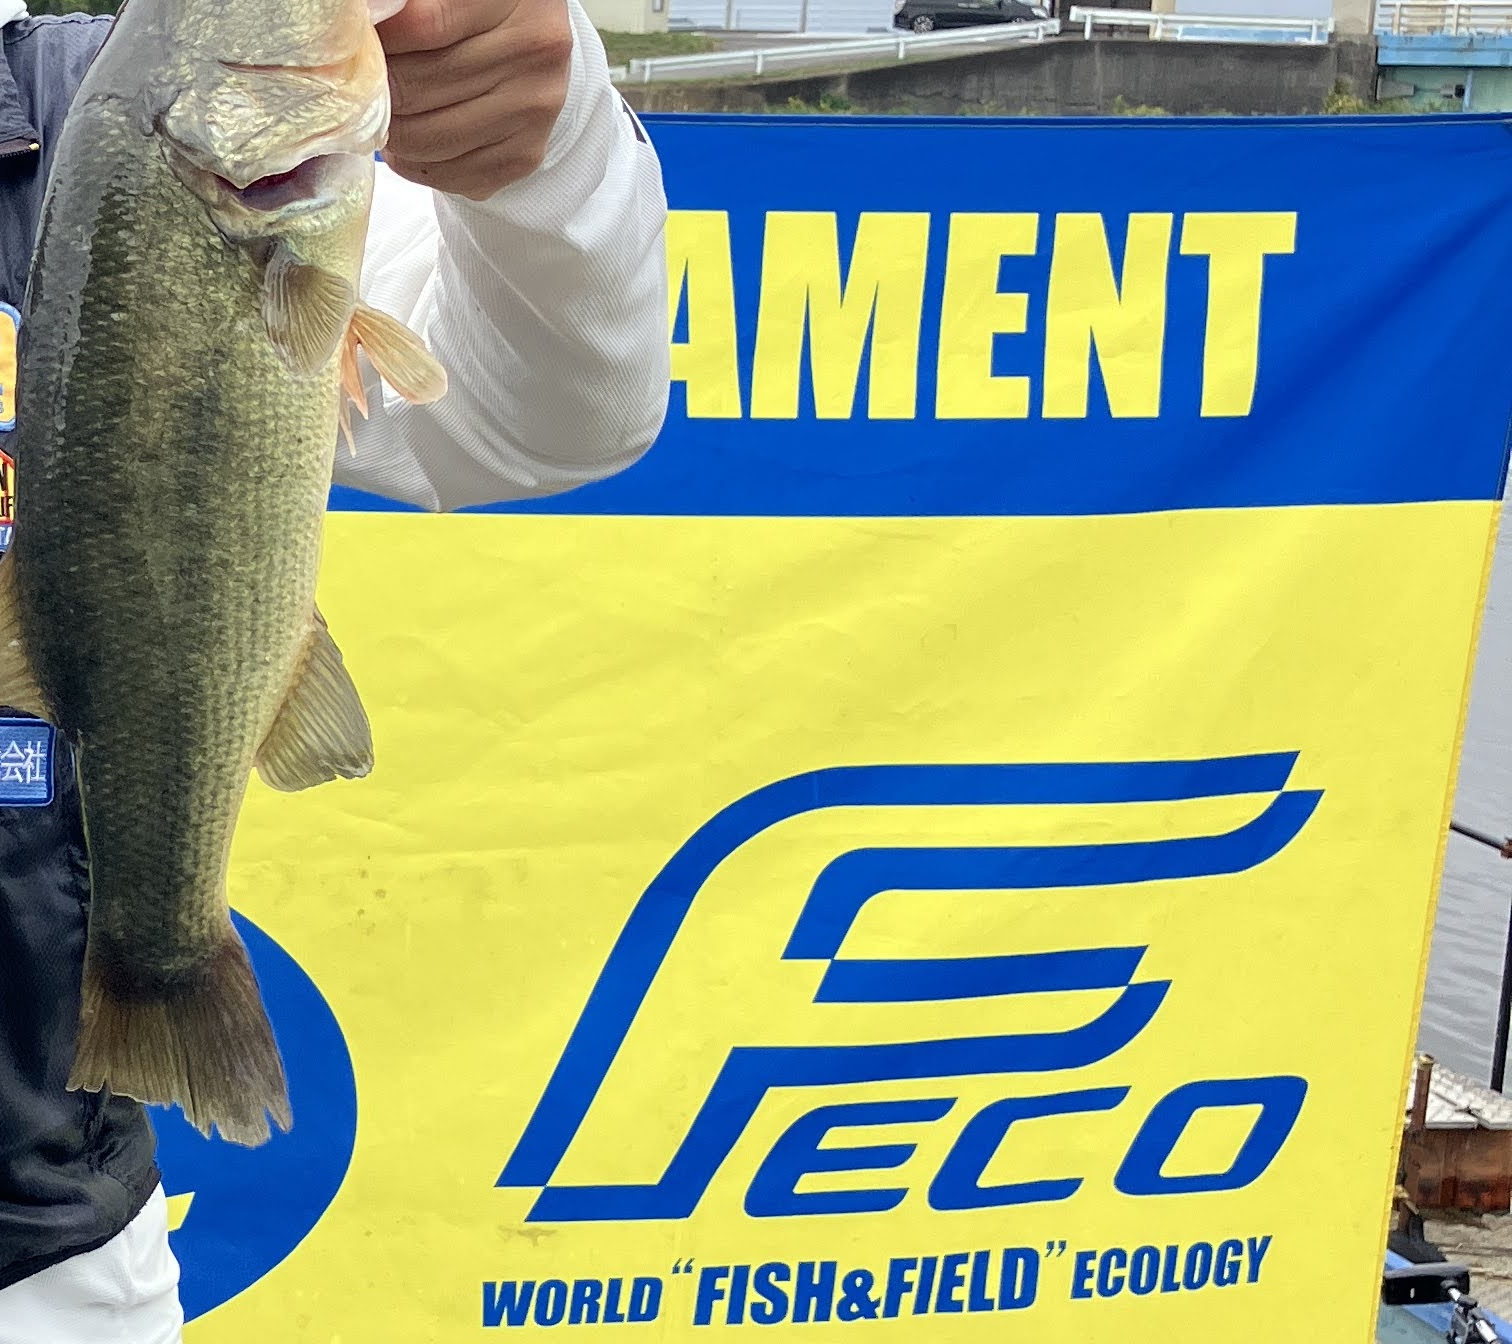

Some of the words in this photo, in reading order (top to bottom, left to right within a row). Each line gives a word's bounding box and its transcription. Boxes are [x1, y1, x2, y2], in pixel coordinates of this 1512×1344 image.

[665, 209, 1298, 420] AMENT
[482, 1275, 662, 1328] WORLD
[1069, 1235, 1273, 1301] ECOLOGY
